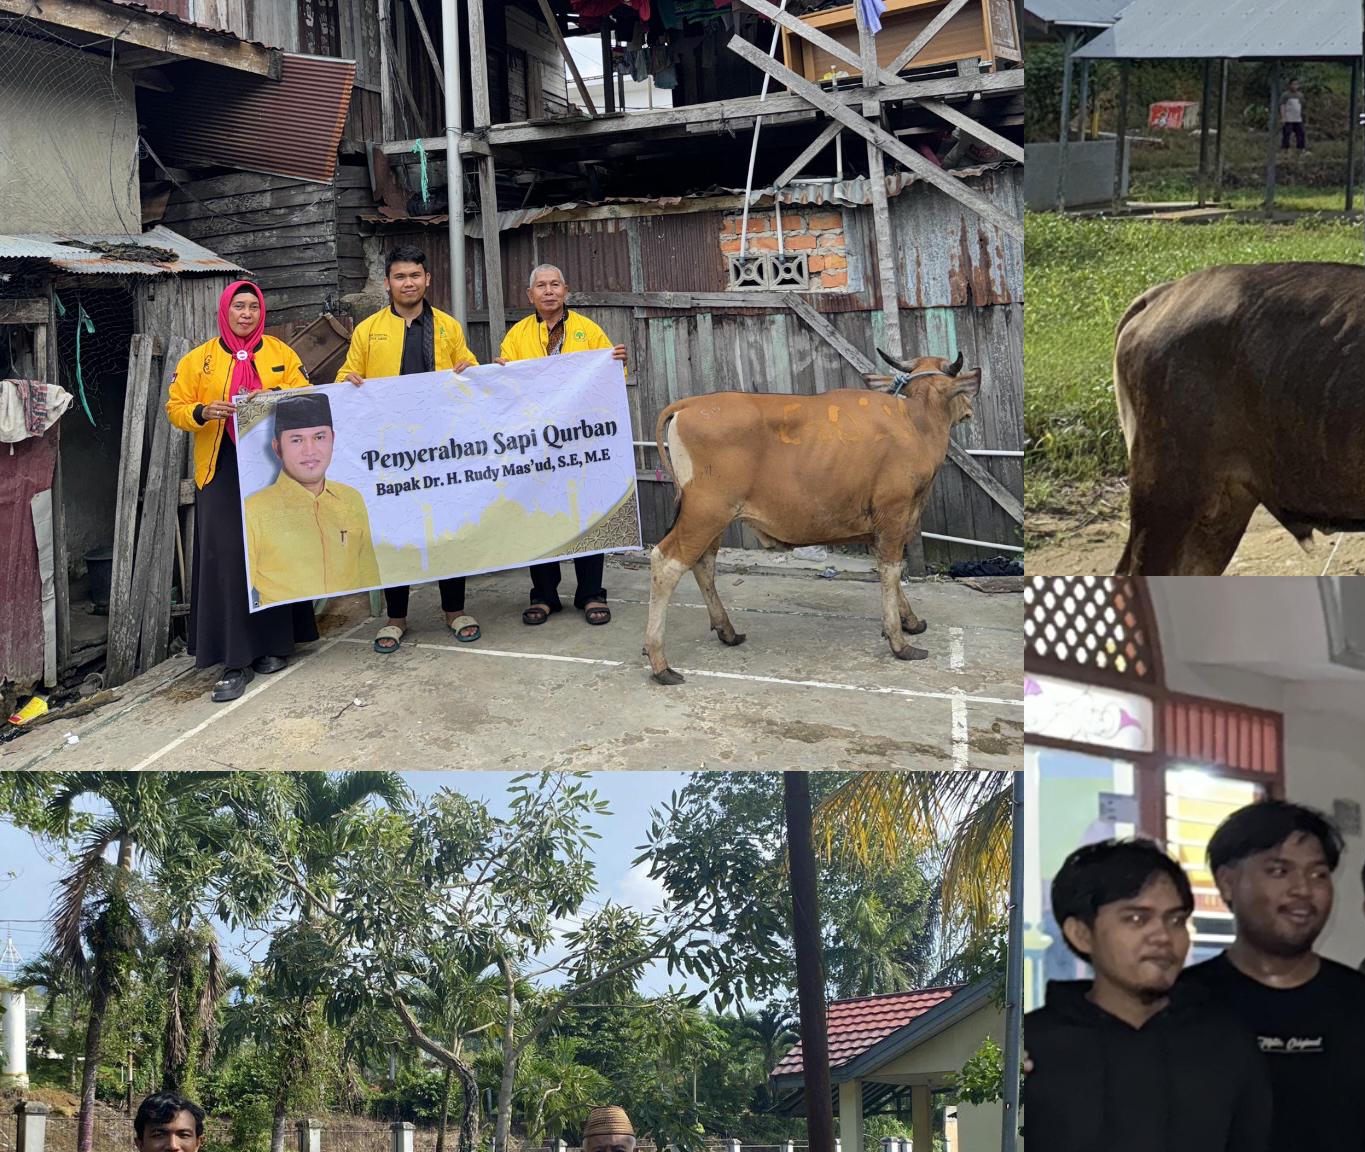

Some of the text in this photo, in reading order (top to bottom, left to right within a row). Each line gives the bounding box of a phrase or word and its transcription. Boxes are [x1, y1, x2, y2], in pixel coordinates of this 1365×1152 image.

[361, 420, 617, 471] Penyerahan Sapi Qurban
[376, 477, 420, 496] Bapak
[423, 476, 444, 488] Dr.
[447, 472, 461, 485] H.
[464, 466, 499, 482] Rudy
[558, 454, 582, 467] S.E,
[584, 449, 610, 463] M.E
